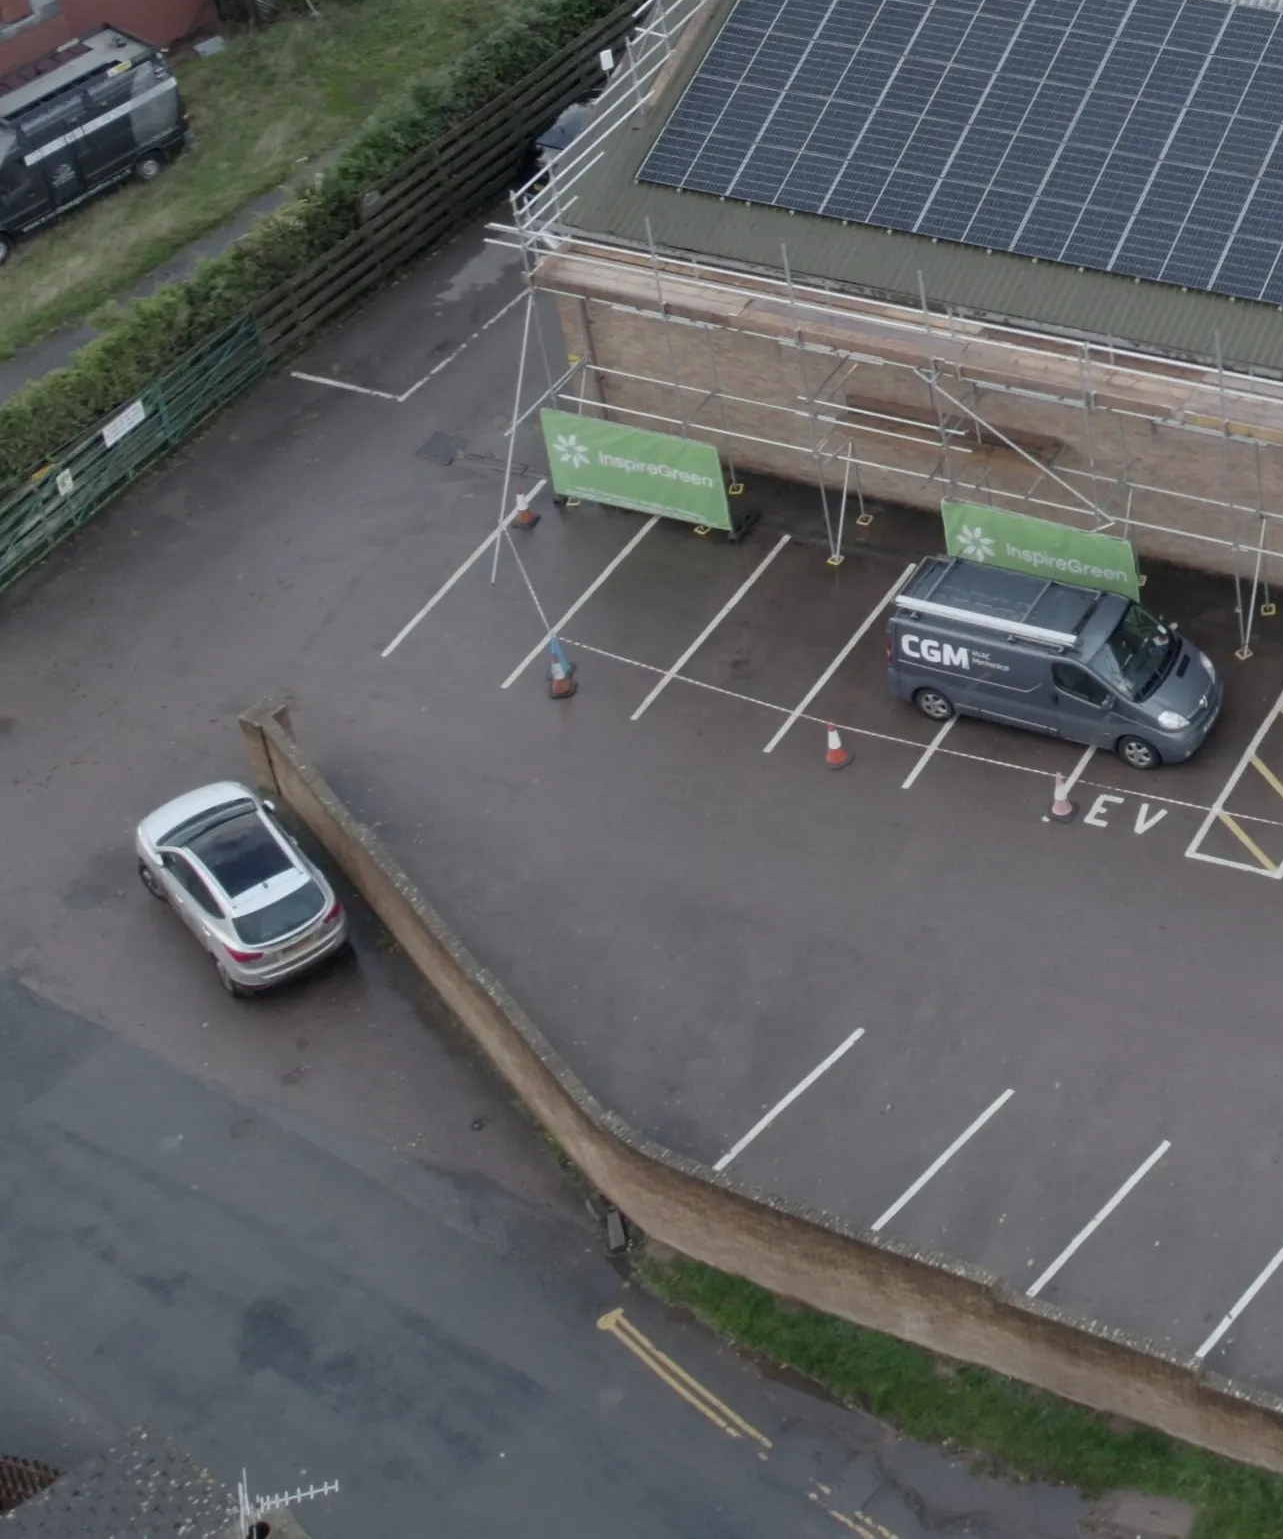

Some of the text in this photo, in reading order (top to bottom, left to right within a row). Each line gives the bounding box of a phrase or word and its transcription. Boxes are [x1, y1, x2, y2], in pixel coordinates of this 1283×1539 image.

[598, 451, 714, 488] InspireGreen
[1006, 543, 1128, 582] InspireGreen
[901, 634, 970, 671] CGM
[1083, 793, 1168, 835] EV
